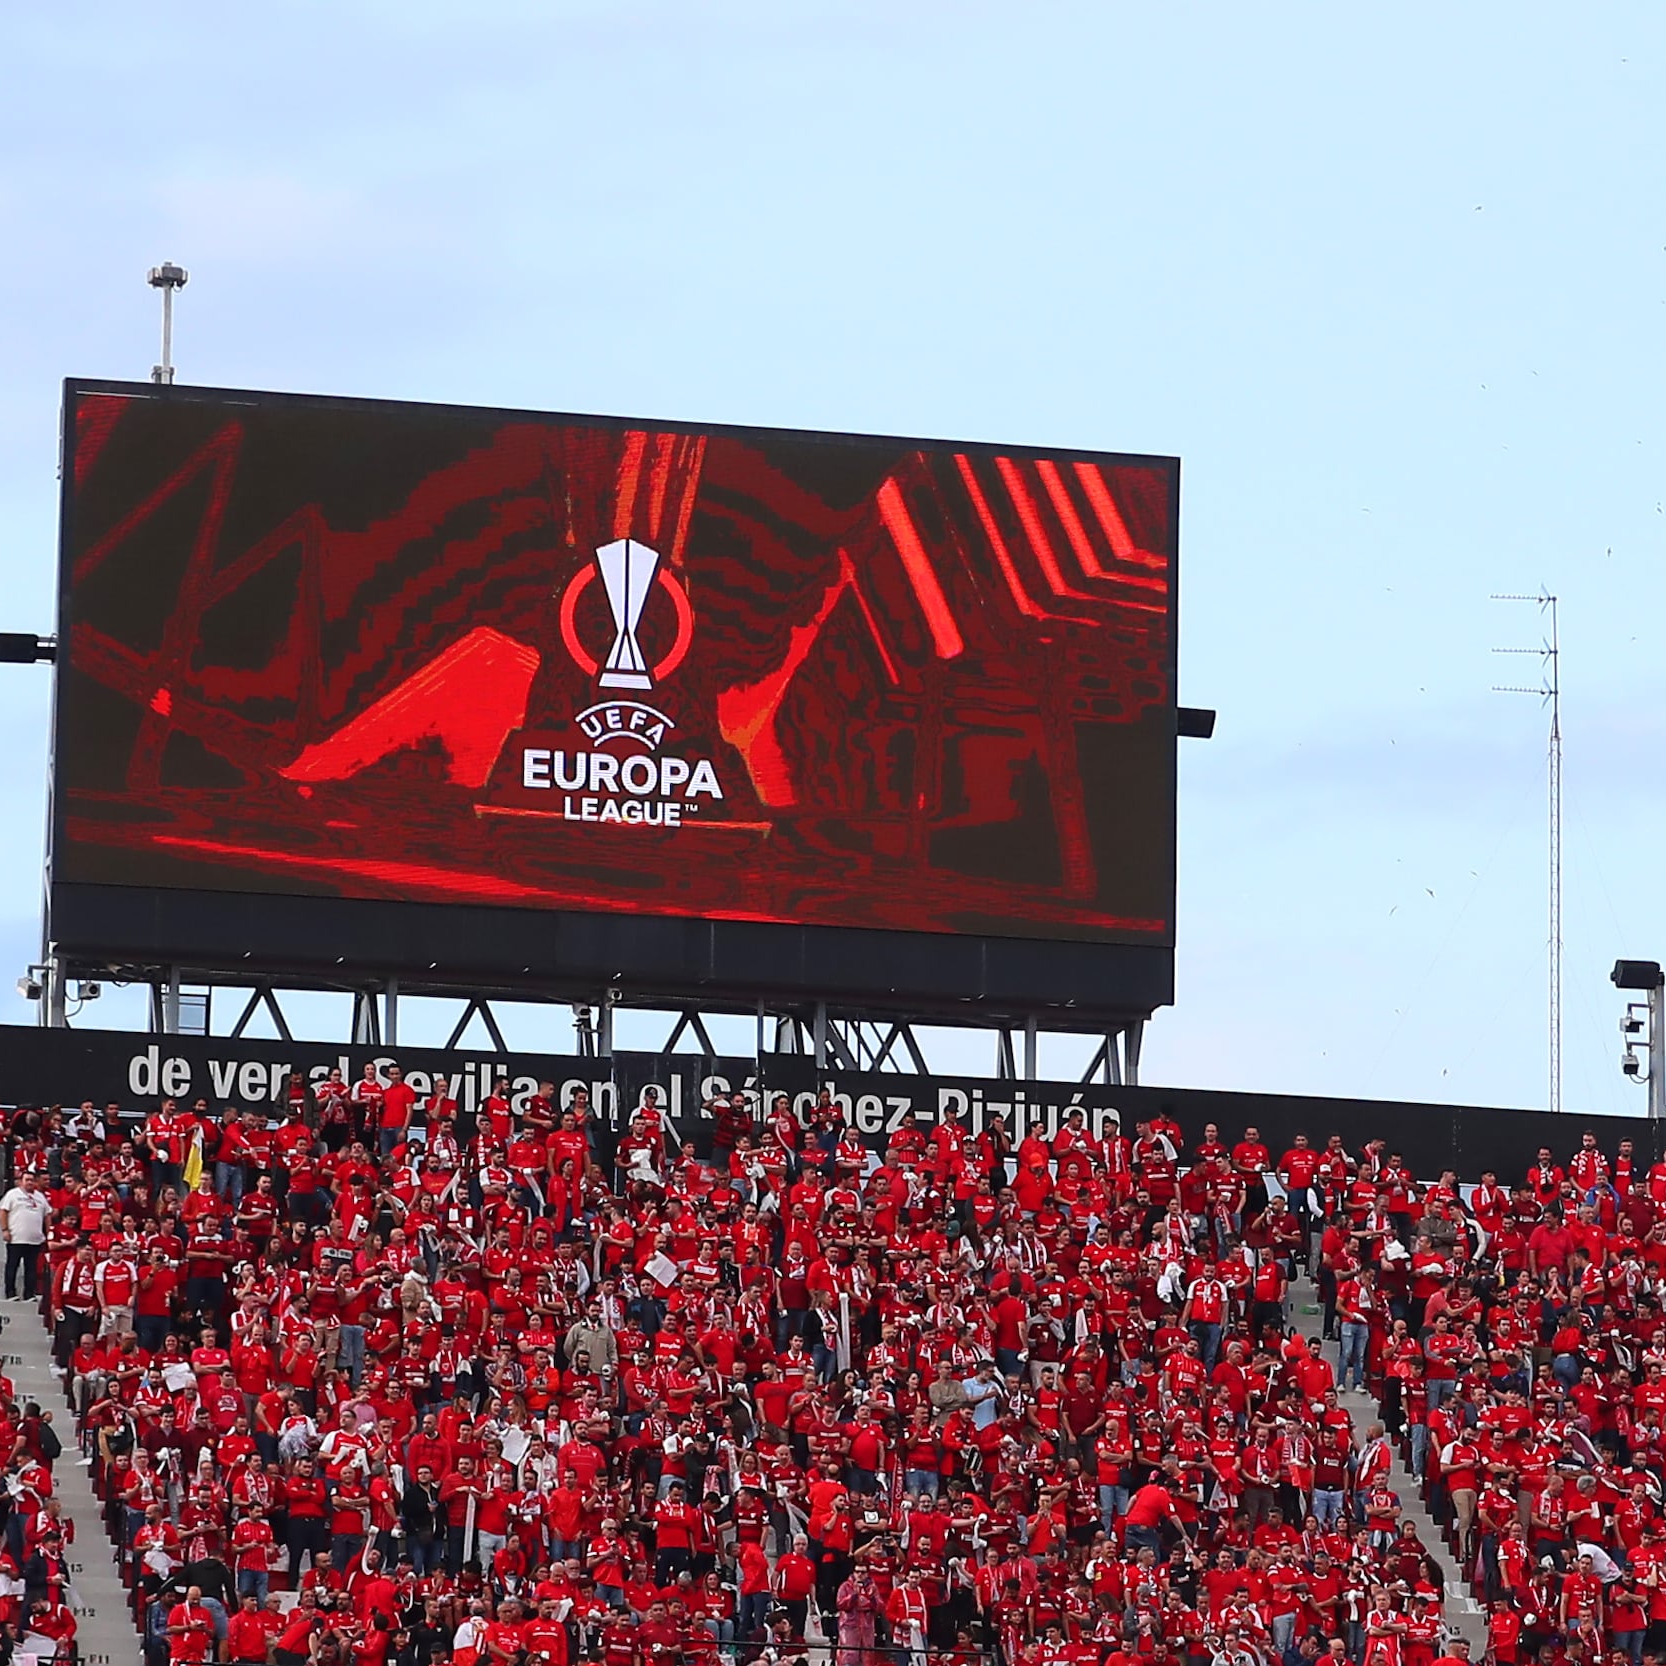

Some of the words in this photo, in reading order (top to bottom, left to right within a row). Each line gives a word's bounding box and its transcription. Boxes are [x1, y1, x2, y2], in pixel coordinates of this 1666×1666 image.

[580, 709, 665, 745] UEFA
[523, 748, 723, 799] EUROPA
[128, 1045, 192, 1098] de
[208, 1059, 291, 1101] ver
[375, 1057, 539, 1115] Sevila
